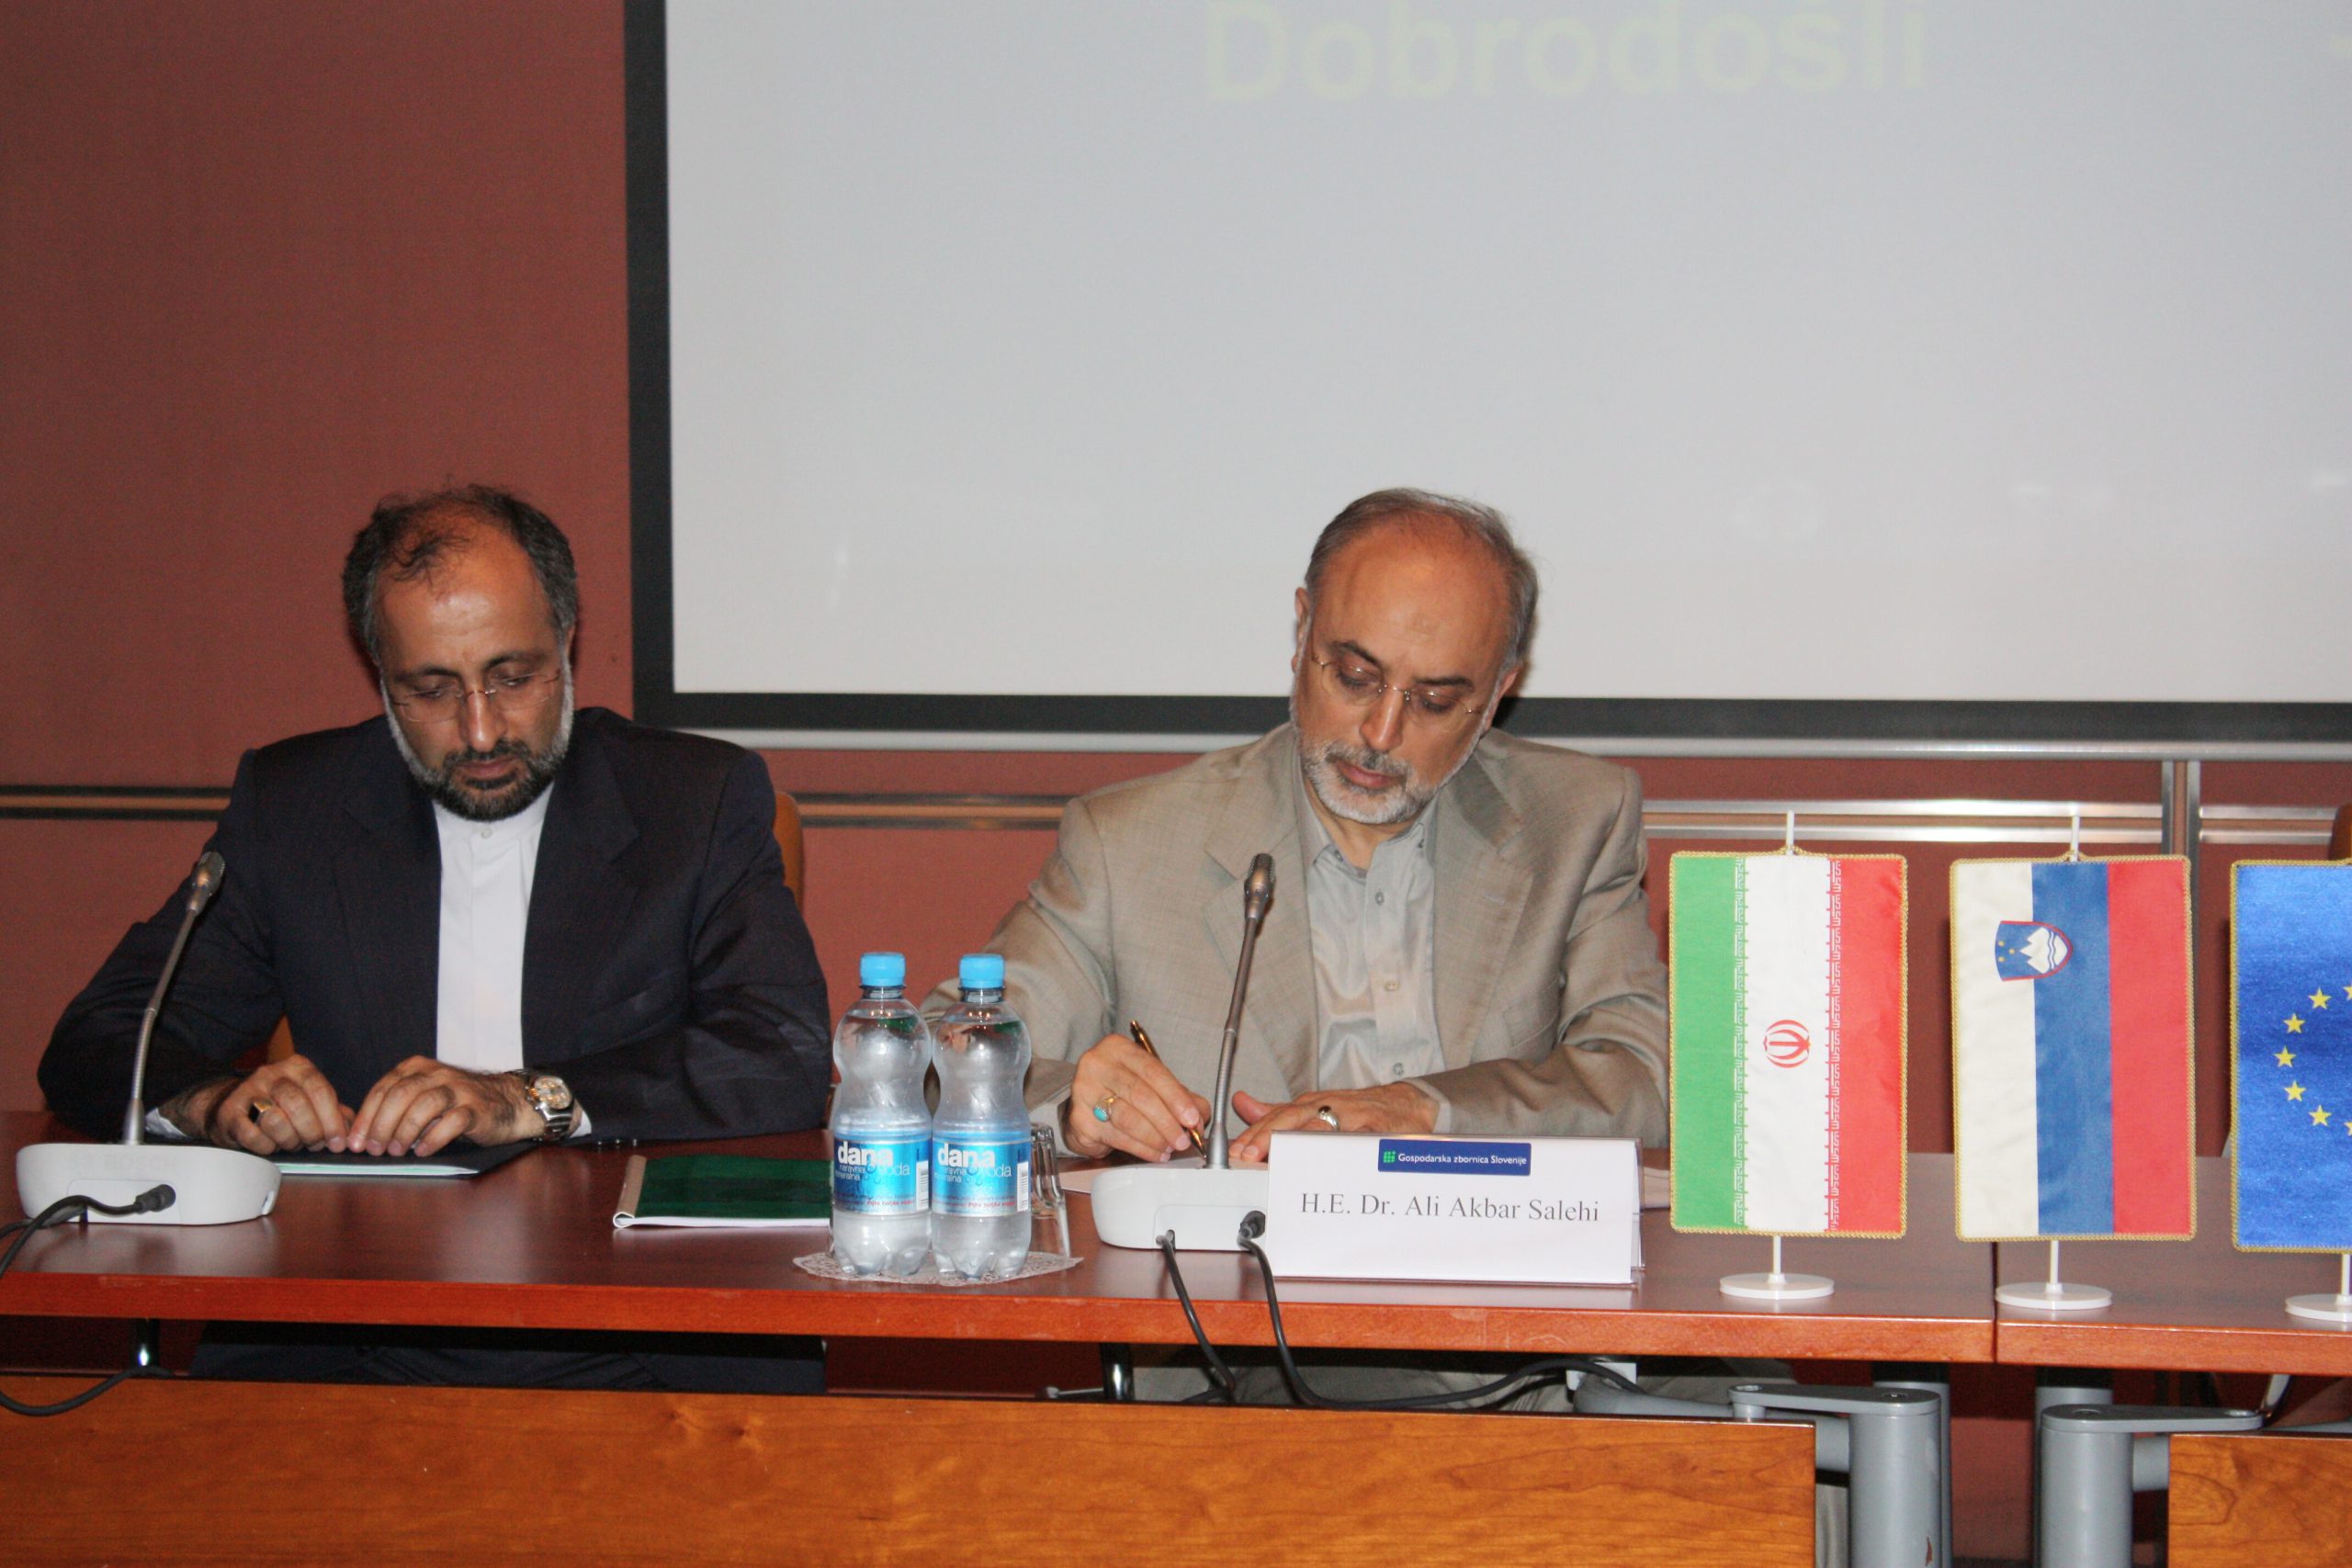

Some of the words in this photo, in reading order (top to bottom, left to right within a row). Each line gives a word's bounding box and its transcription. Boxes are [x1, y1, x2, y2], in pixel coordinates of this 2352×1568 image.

[838, 1141, 893, 1168] dana
[938, 1142, 995, 1168] dana
[1397, 1153, 1452, 1164] Gospodarska
[1453, 1156, 1489, 1164] zbornica
[1490, 1155, 1527, 1167] Slovenije
[1301, 1192, 1351, 1214] H.E.
[1361, 1194, 1396, 1215] Dr.
[1405, 1195, 1440, 1217] Ali
[1448, 1197, 1521, 1220] Akbar
[1528, 1199, 1600, 1222] Salehi
